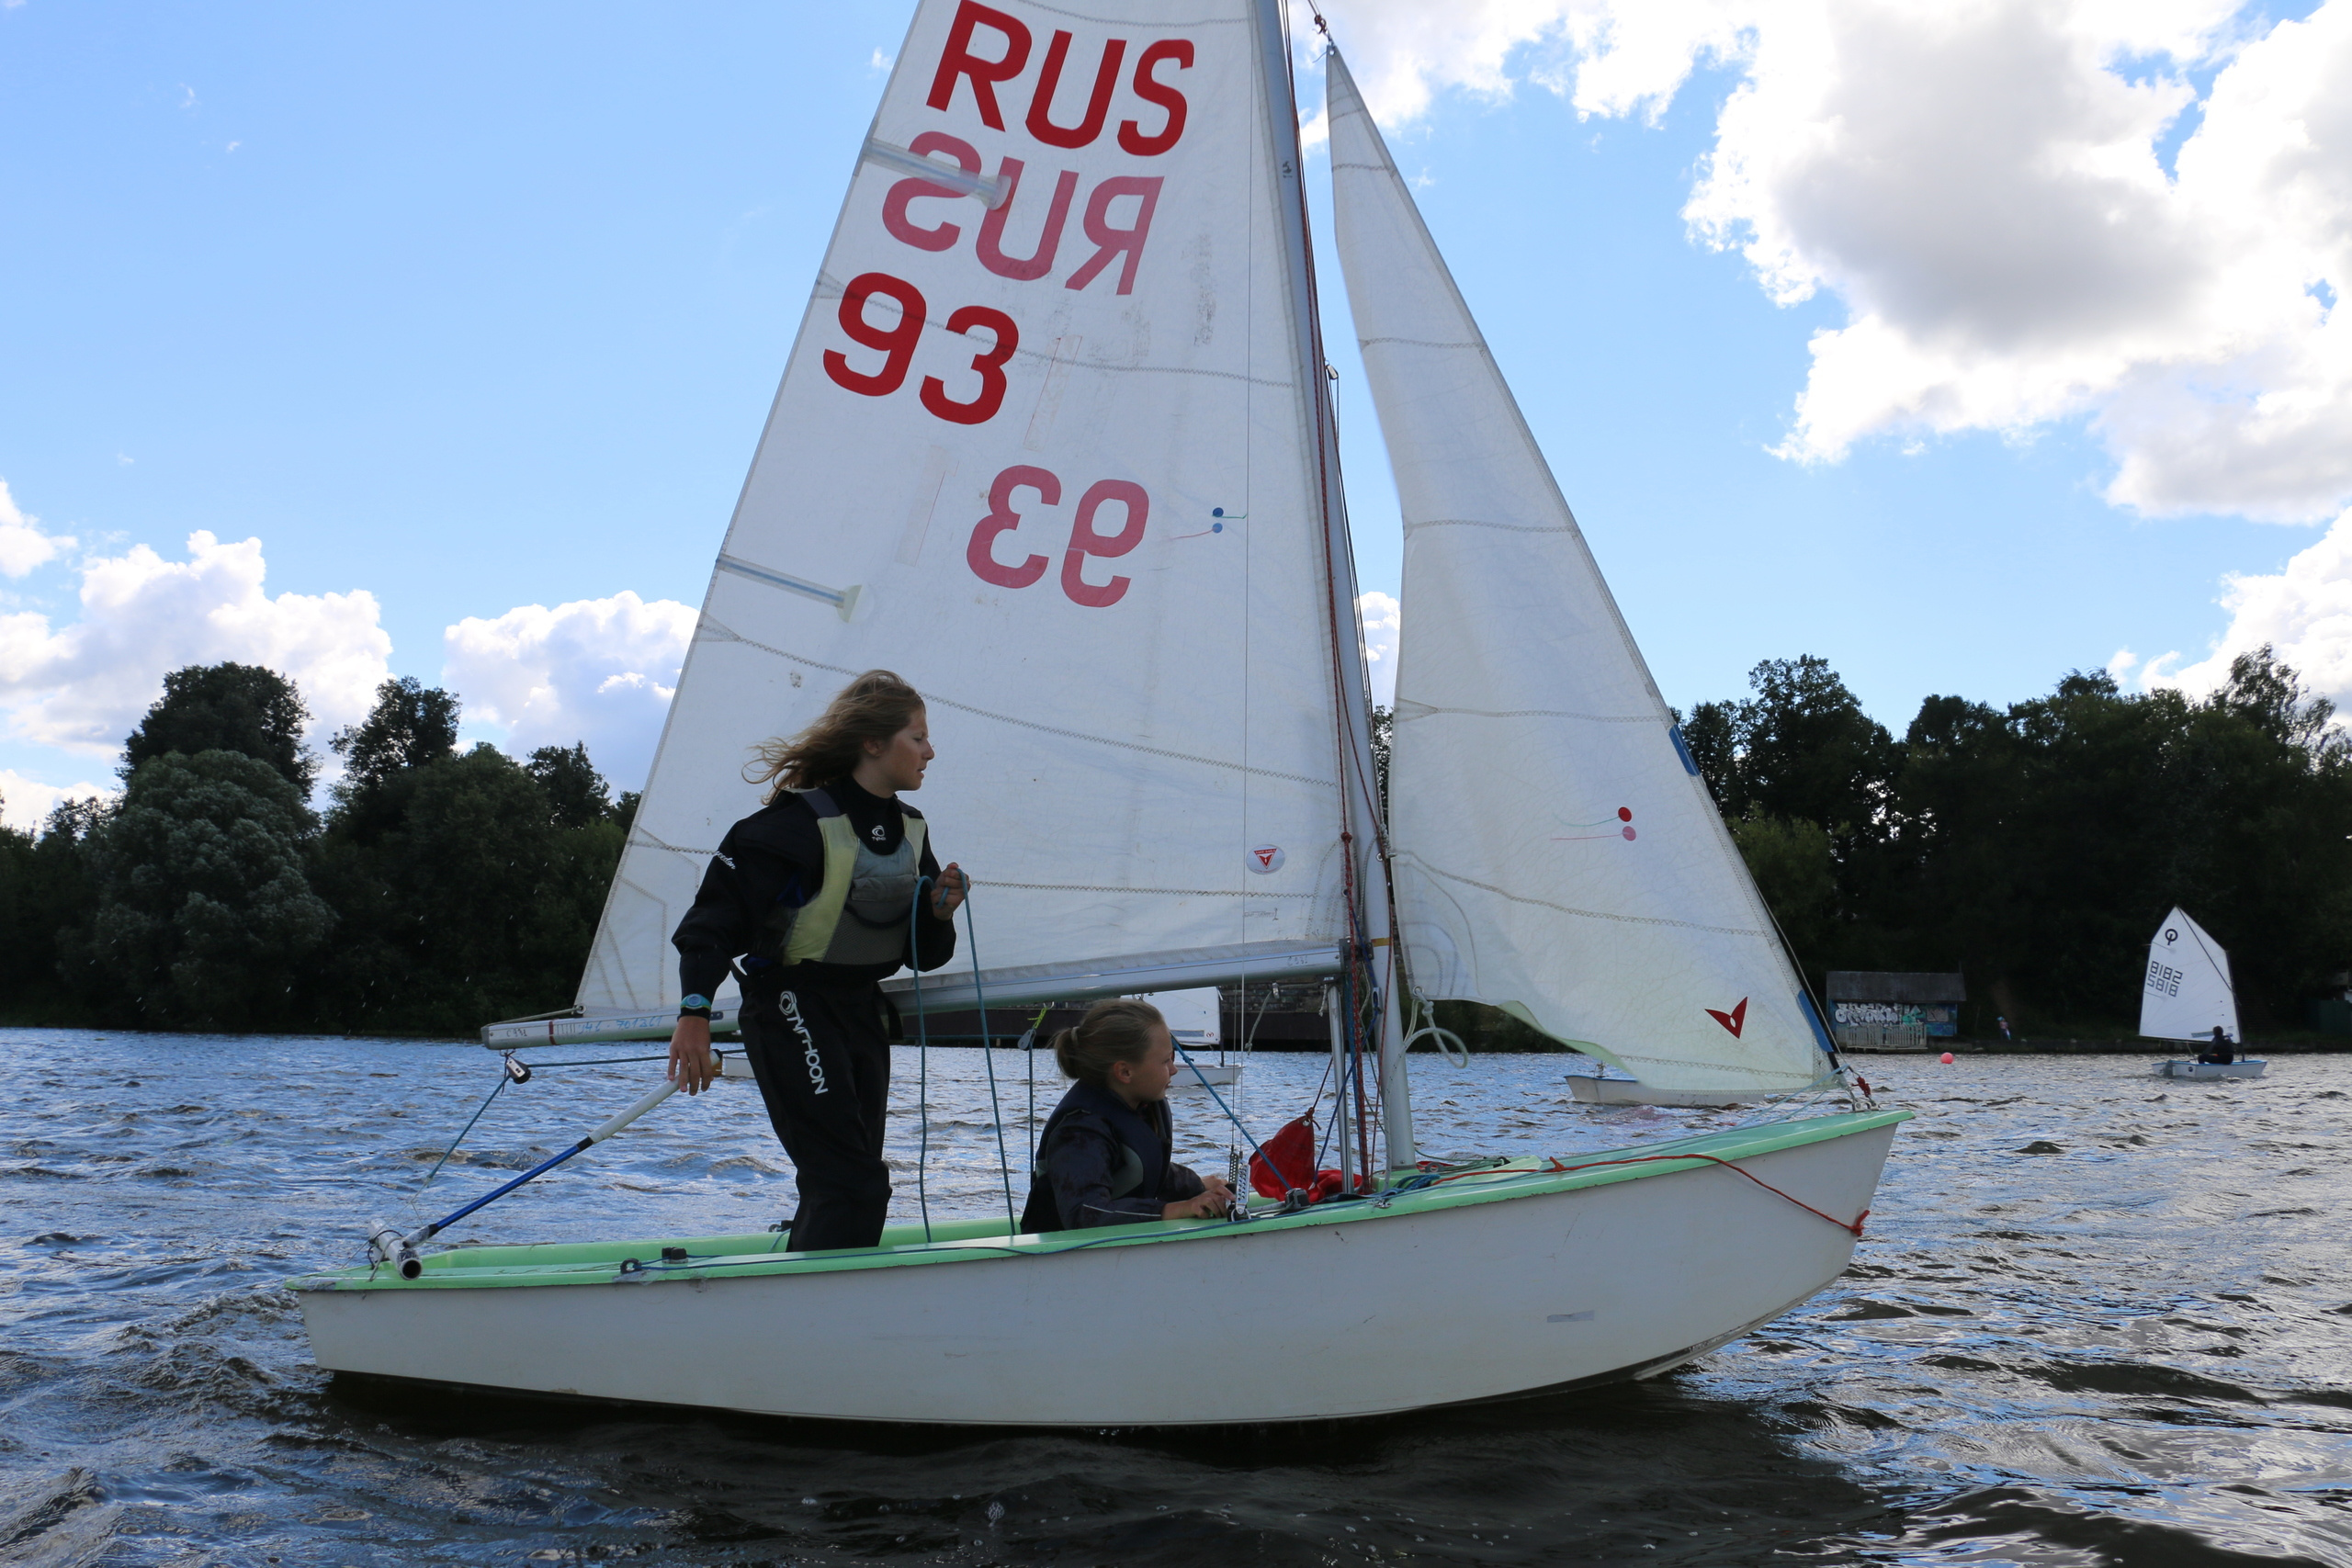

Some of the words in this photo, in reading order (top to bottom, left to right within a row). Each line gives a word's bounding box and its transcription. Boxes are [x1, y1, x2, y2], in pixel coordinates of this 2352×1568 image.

[926, 0, 1194, 156] RUS
[823, 273, 1019, 425] 93
[2150, 960, 2183, 985] 8182
[786, 1001, 829, 1095] TYPHOON
